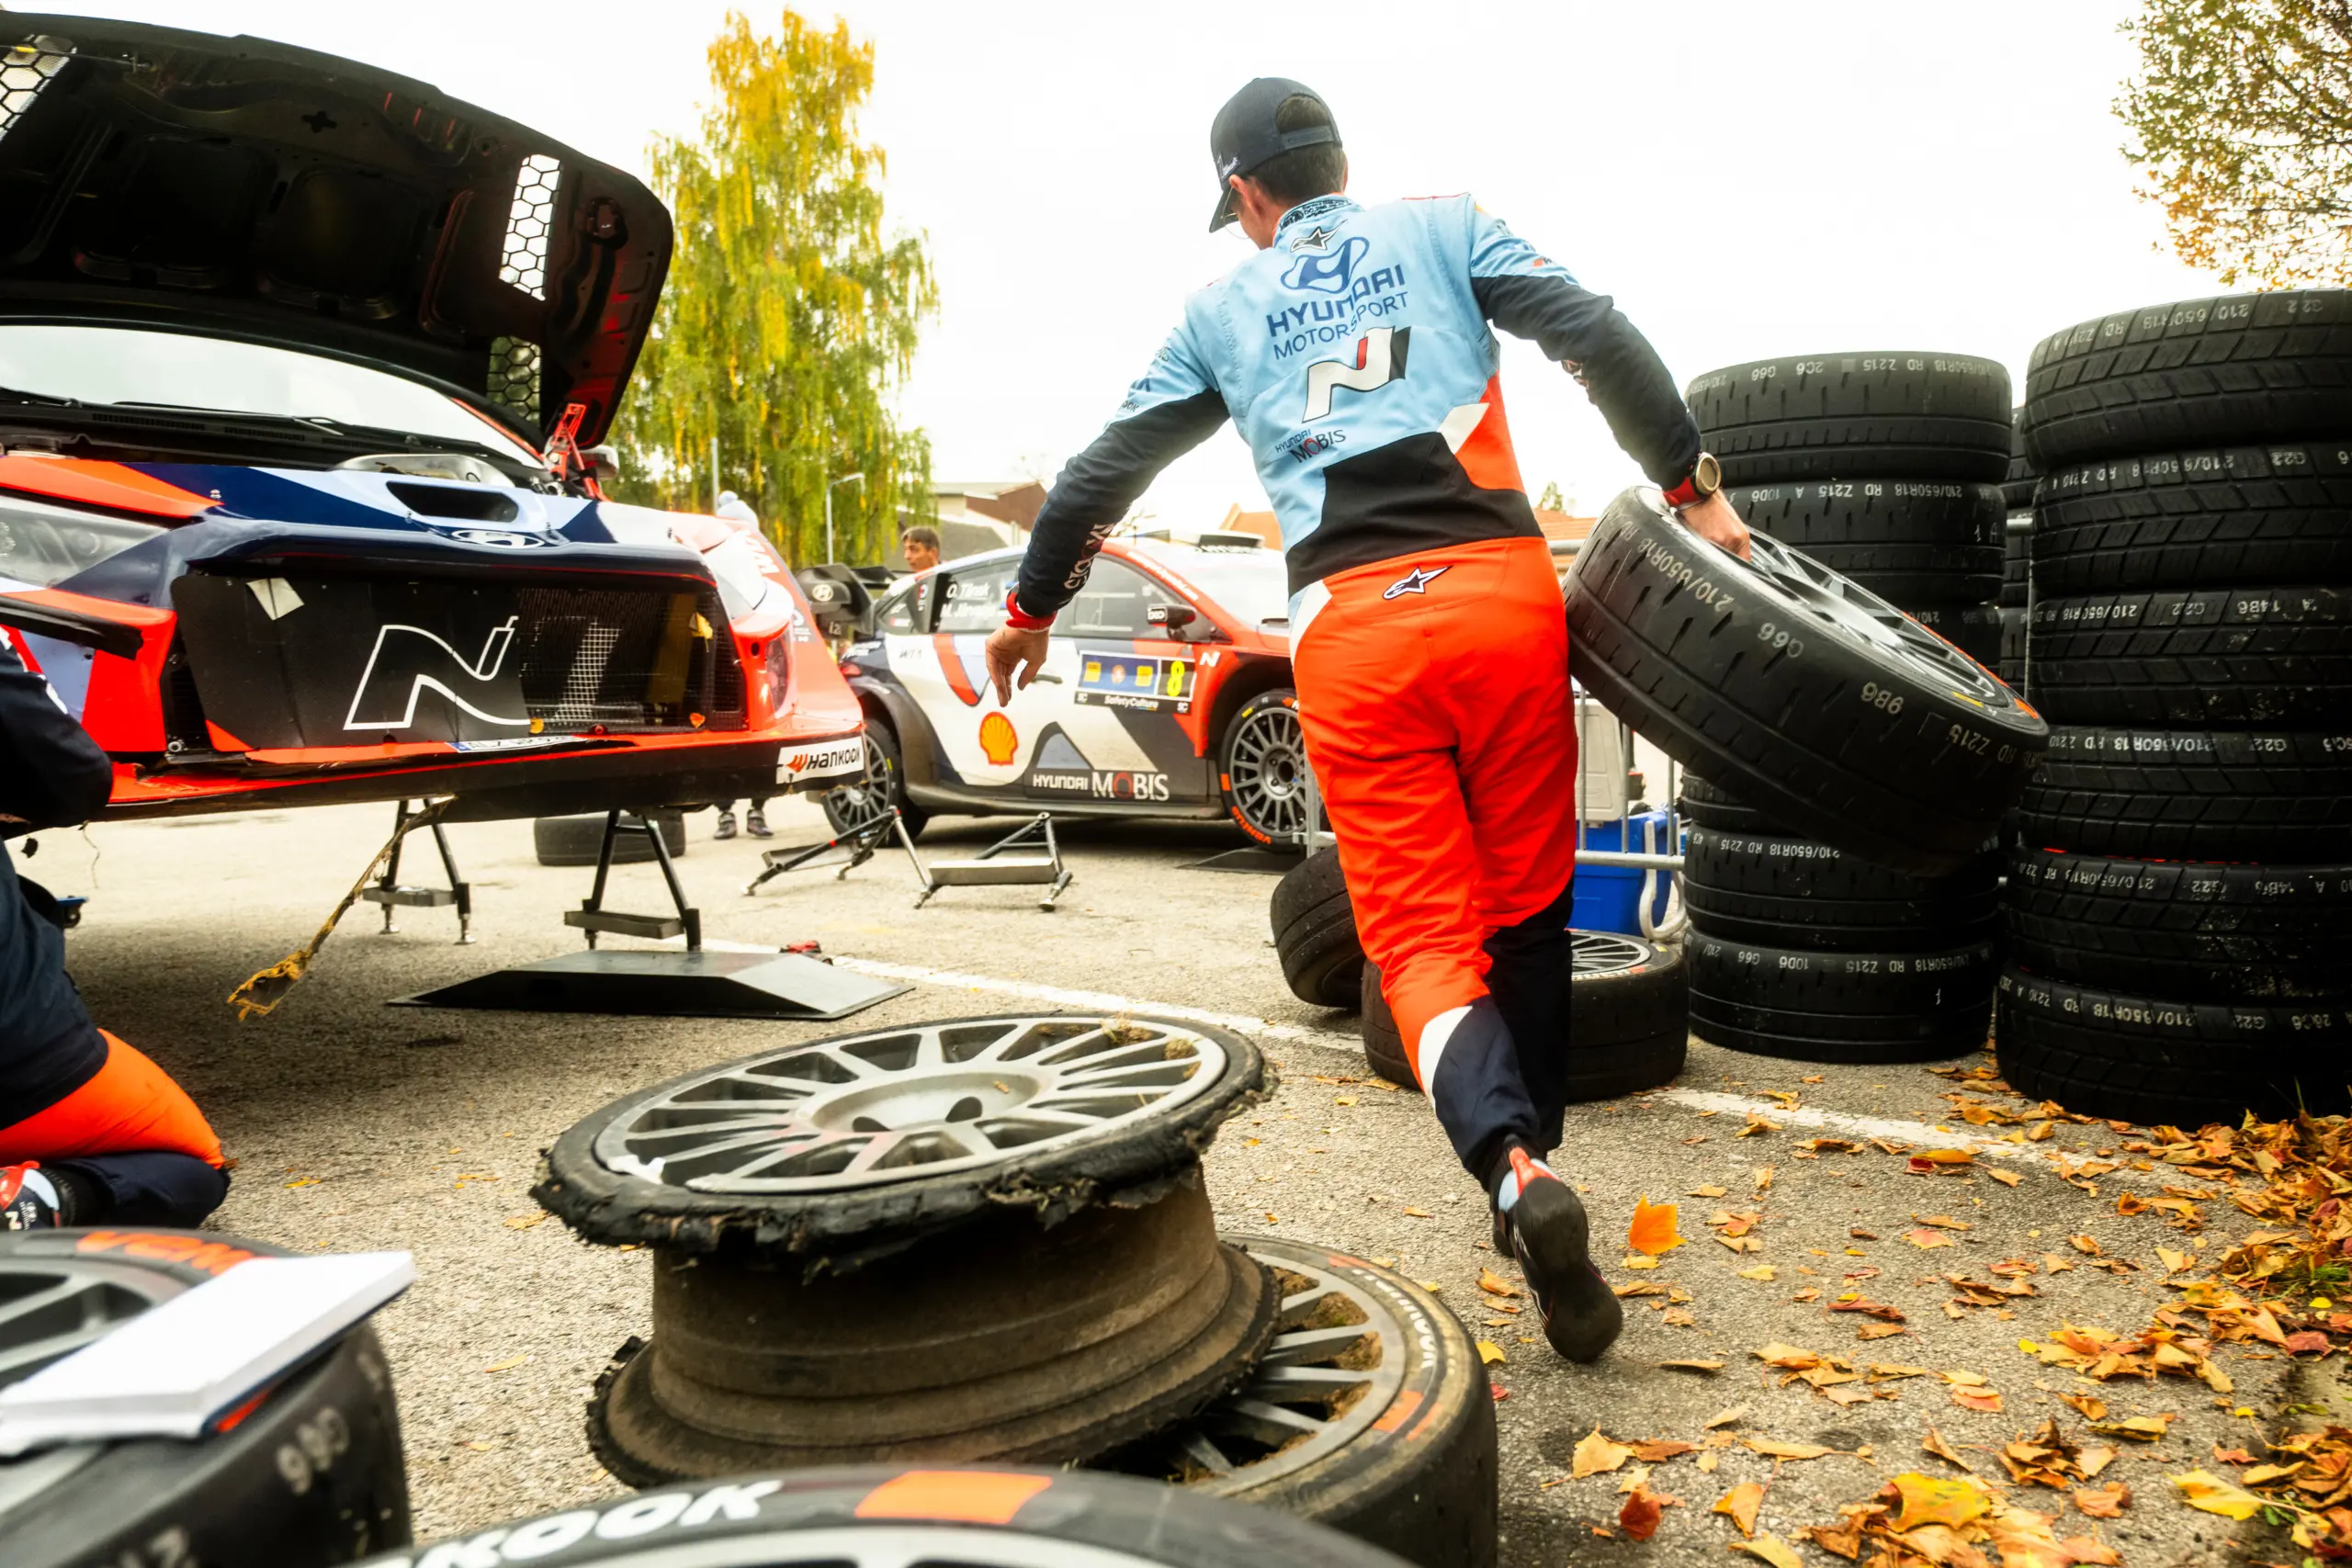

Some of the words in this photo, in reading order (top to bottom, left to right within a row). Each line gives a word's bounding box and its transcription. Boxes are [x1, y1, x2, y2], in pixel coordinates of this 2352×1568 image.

[1266, 264, 1406, 337] HYUNDAI
[1272, 291, 1408, 360] MOTORSPORT
[1795, 361, 1824, 376] 2C6
[1863, 358, 1897, 371] Z215
[1906, 359, 1924, 371] RD
[1751, 366, 1777, 381] G66
[1275, 429, 1312, 453] HYUNDAI
[1289, 430, 1347, 463] MOBIS
[1750, 488, 1781, 503] 10D6
[1794, 486, 1805, 499] A
[1818, 484, 1853, 499] Z215
[1864, 483, 1883, 497] RD
[1894, 483, 1963, 499] 210/650R18
[2237, 599, 2281, 615] 14B6
[1199, 650, 1221, 667] N
[1166, 660, 1185, 697] 8
[1104, 695, 1159, 709] SafetyCulture
[1860, 682, 1905, 715] 9B6
[1948, 723, 1991, 757] Z215
[1033, 773, 1088, 790] HYUNDAI
[1091, 772, 1170, 801] MOBIS
[1720, 838, 1744, 852] Z215
[1747, 841, 1764, 855] RD
[2314, 880, 2326, 894] A
[1737, 952, 1760, 966] G66
[1779, 955, 1809, 971] 10D6
[1845, 960, 1879, 974] Z215
[1888, 961, 1905, 974] RD
